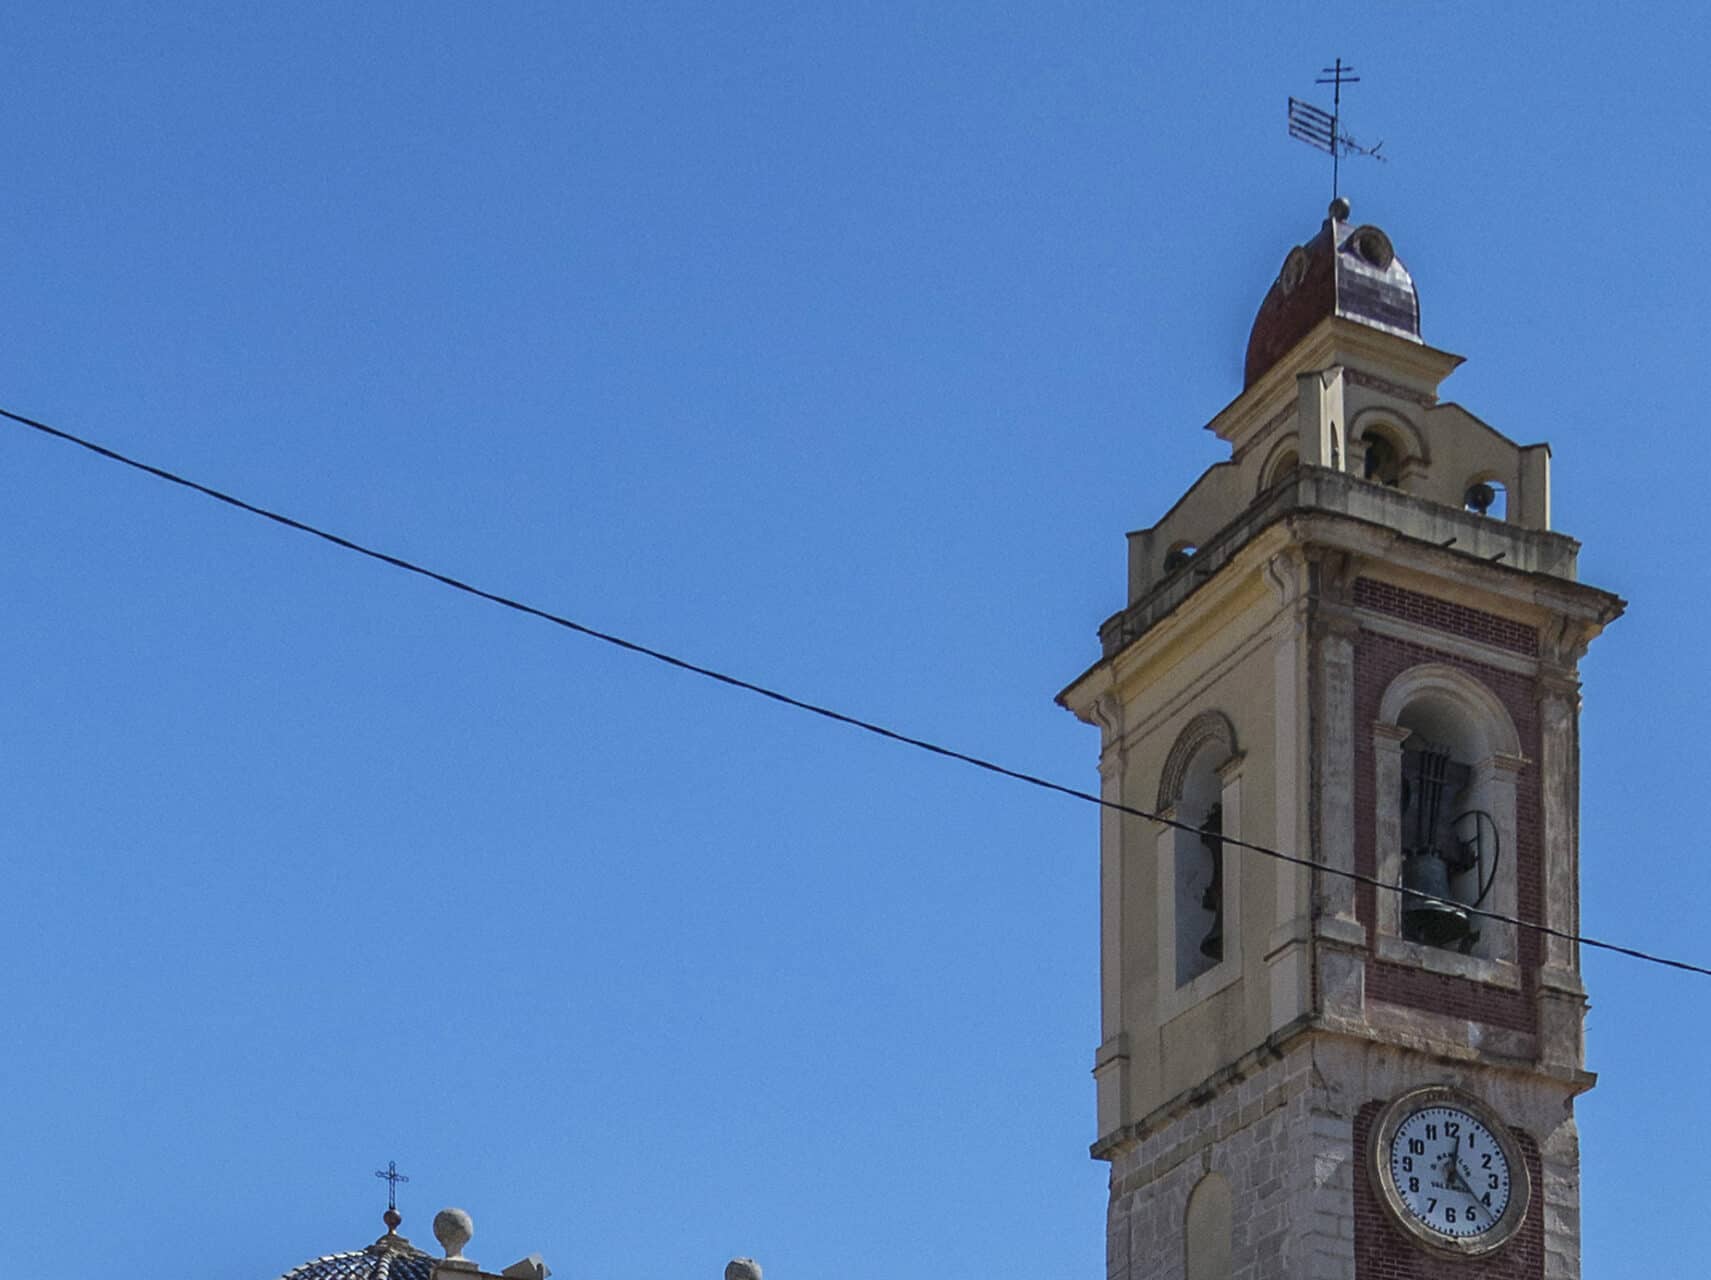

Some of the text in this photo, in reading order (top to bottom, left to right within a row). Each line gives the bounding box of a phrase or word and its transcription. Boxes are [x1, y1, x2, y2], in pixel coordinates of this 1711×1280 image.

[1426, 1124, 1437, 1140] 11
[1445, 1122, 1459, 1138] 12
[1408, 1138, 1424, 1155] 10
[1469, 1133, 1474, 1148] 1
[1402, 1157, 1412, 1172] 9
[1482, 1154, 1491, 1170] 2
[1409, 1177, 1419, 1192] 8
[1488, 1174, 1498, 1189] 3
[1428, 1198, 1437, 1213] 7
[1482, 1192, 1491, 1207] 4
[1446, 1208, 1456, 1223] 6
[1466, 1206, 1476, 1221] 5
